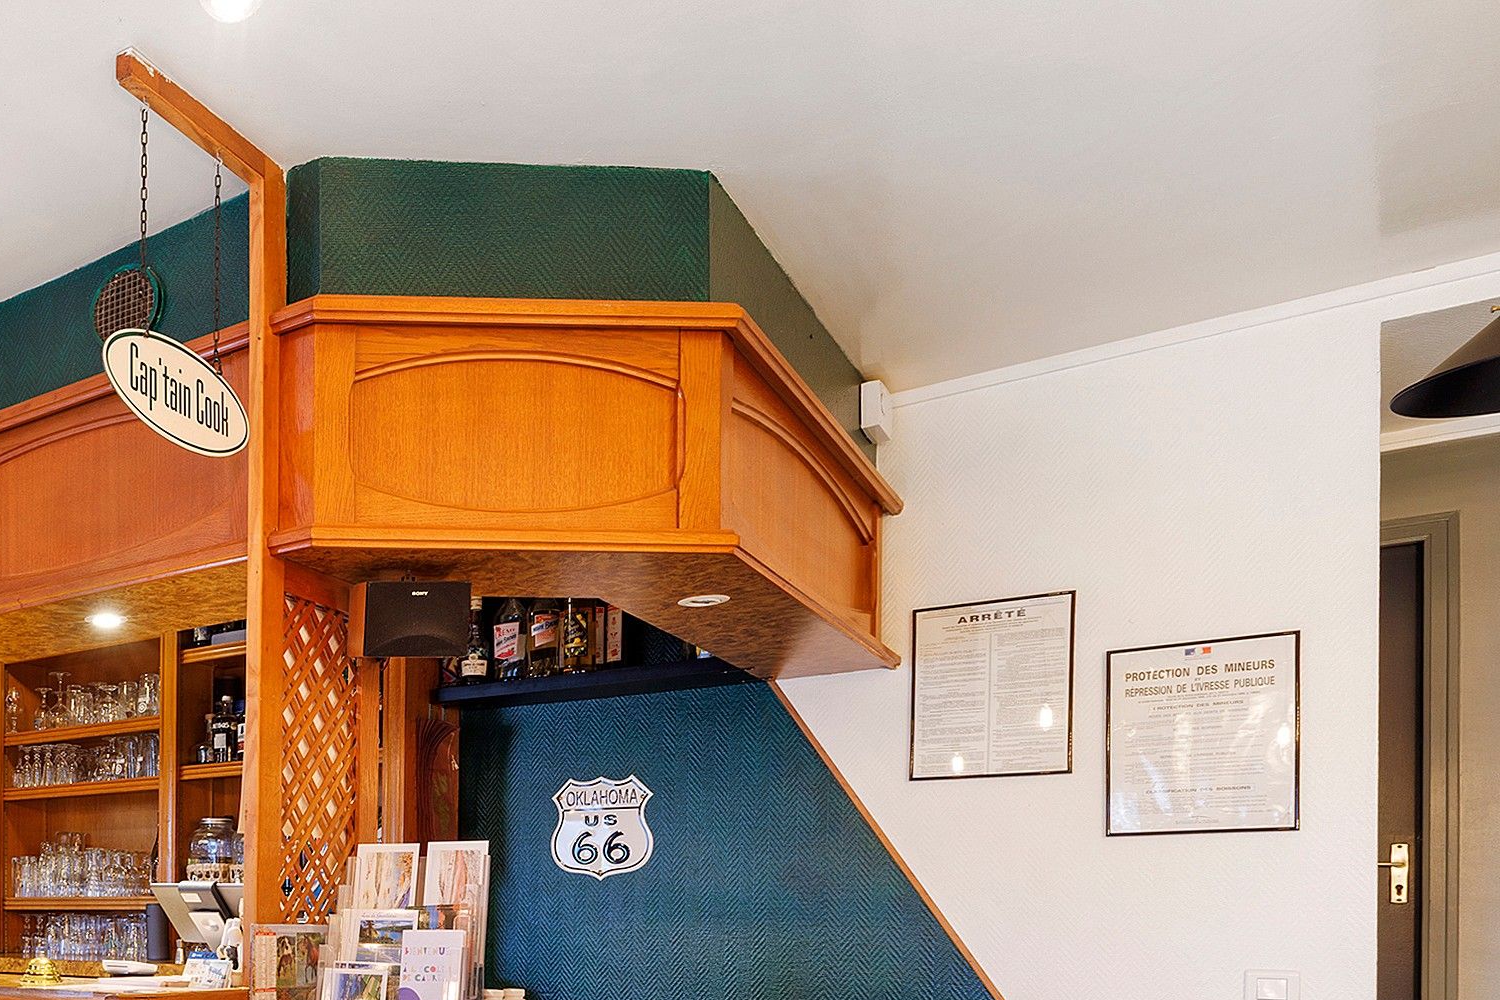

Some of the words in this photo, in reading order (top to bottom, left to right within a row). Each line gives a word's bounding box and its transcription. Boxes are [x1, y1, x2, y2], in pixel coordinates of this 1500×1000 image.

[130, 342, 191, 419] Cap'tain
[196, 379, 229, 437] Cook
[957, 607, 1026, 624] ARRÊTÉ
[1125, 667, 1190, 682] PROTECTION
[1196, 665, 1218, 676] DES
[1224, 659, 1275, 673] MINEURS
[1176, 684, 1187, 693] DE
[1190, 680, 1230, 692] L'IVRESSE
[1234, 676, 1275, 688] PUBLIQUE
[566, 789, 638, 807] OKLAHOMA
[572, 831, 630, 865] 66
